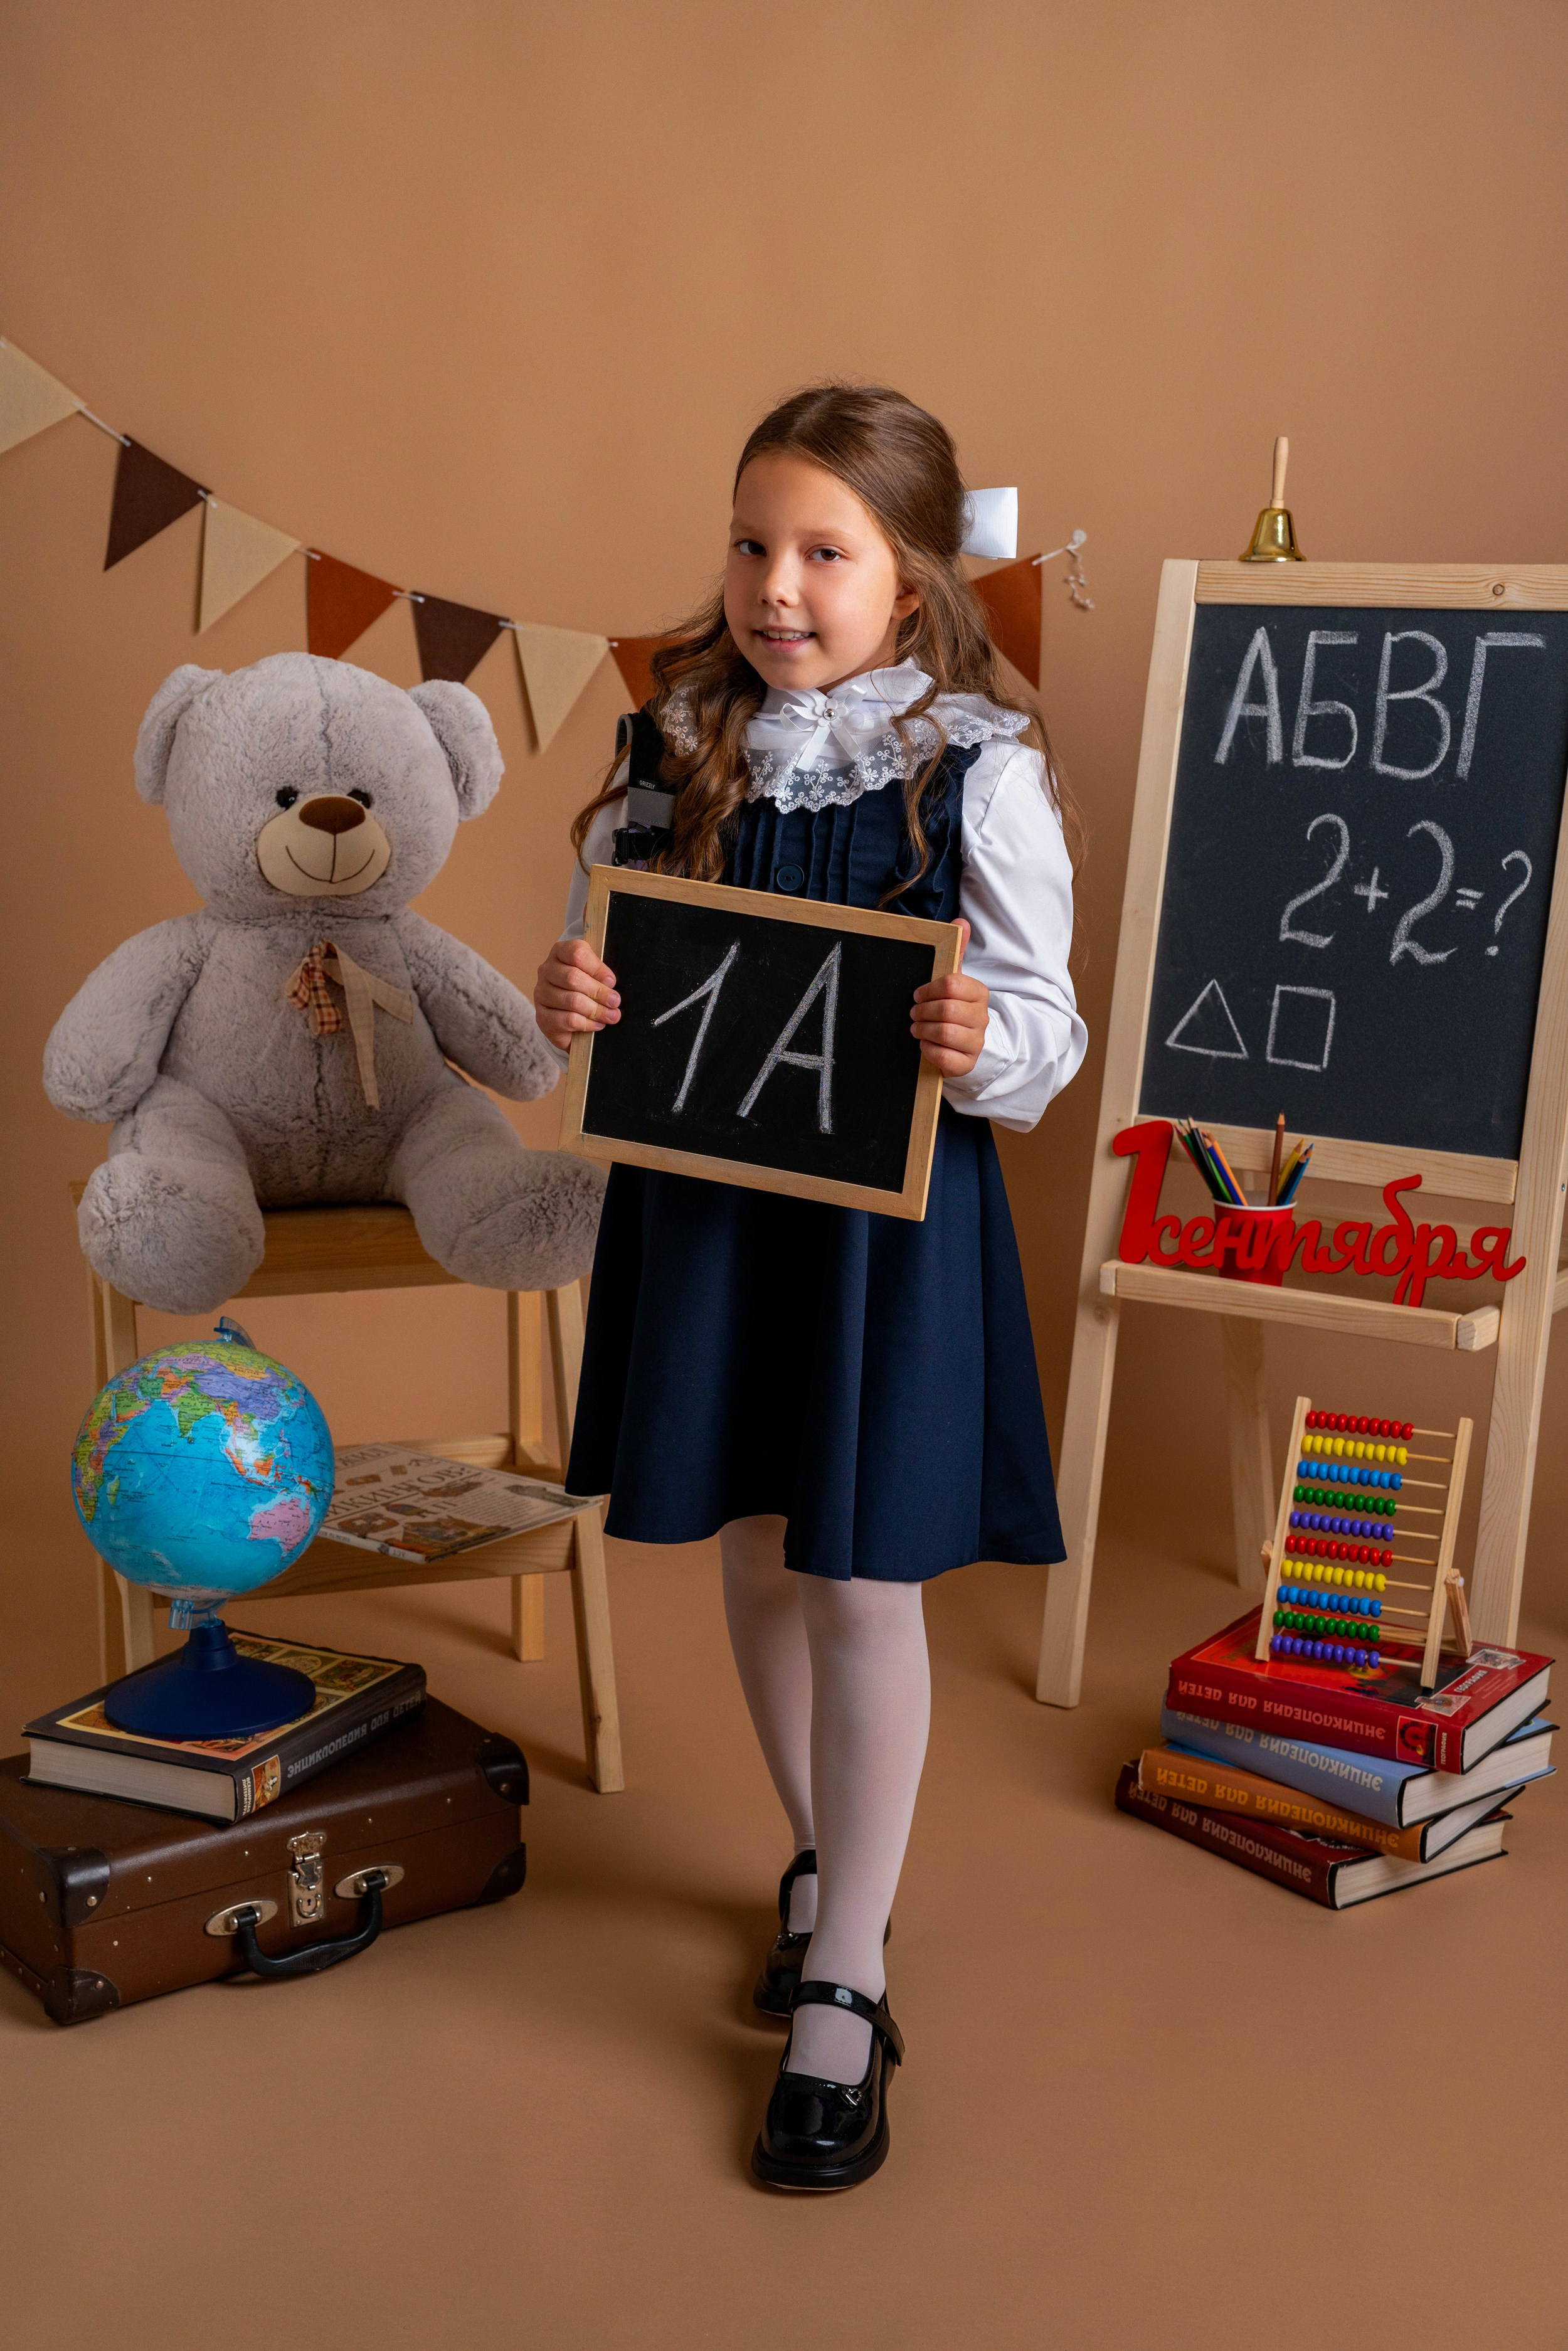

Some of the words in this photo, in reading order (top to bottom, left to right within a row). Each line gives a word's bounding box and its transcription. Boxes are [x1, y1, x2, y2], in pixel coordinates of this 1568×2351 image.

[1214, 627, 1547, 782] АБВГ
[639, 780, 655, 790] GRIZZLY
[1148, 1174, 1526, 1308] сентября
[1177, 1680, 1222, 1701] ДЕТЕЙ
[1453, 1669, 1488, 1693] ГЕОГРАФИЯ
[1227, 1692, 1258, 1710] ДЛЯ
[1224, 1722, 1254, 1743] ДЛЯ
[1263, 1700, 1386, 1741] ЭНЦИКЛОПЕДИЯ
[287, 1723, 368, 1779] ЭНЦИКЛОПЕДИЯ
[370, 1710, 389, 1731] ДЛЯ
[1258, 1733, 1384, 1792] ЭНЦИКЛОПЕДИЯ
[1156, 1767, 1207, 1795] ДЕТЕЙ
[1214, 1783, 1249, 1806] ДЛЯ
[1171, 1802, 1199, 1827] ДЛЯ
[1255, 1795, 1400, 1849] ЭНЦИКЛОПЕДИЯ
[1201, 1817, 1313, 1884] ЭНЦИКЛОПЕДИЯ
